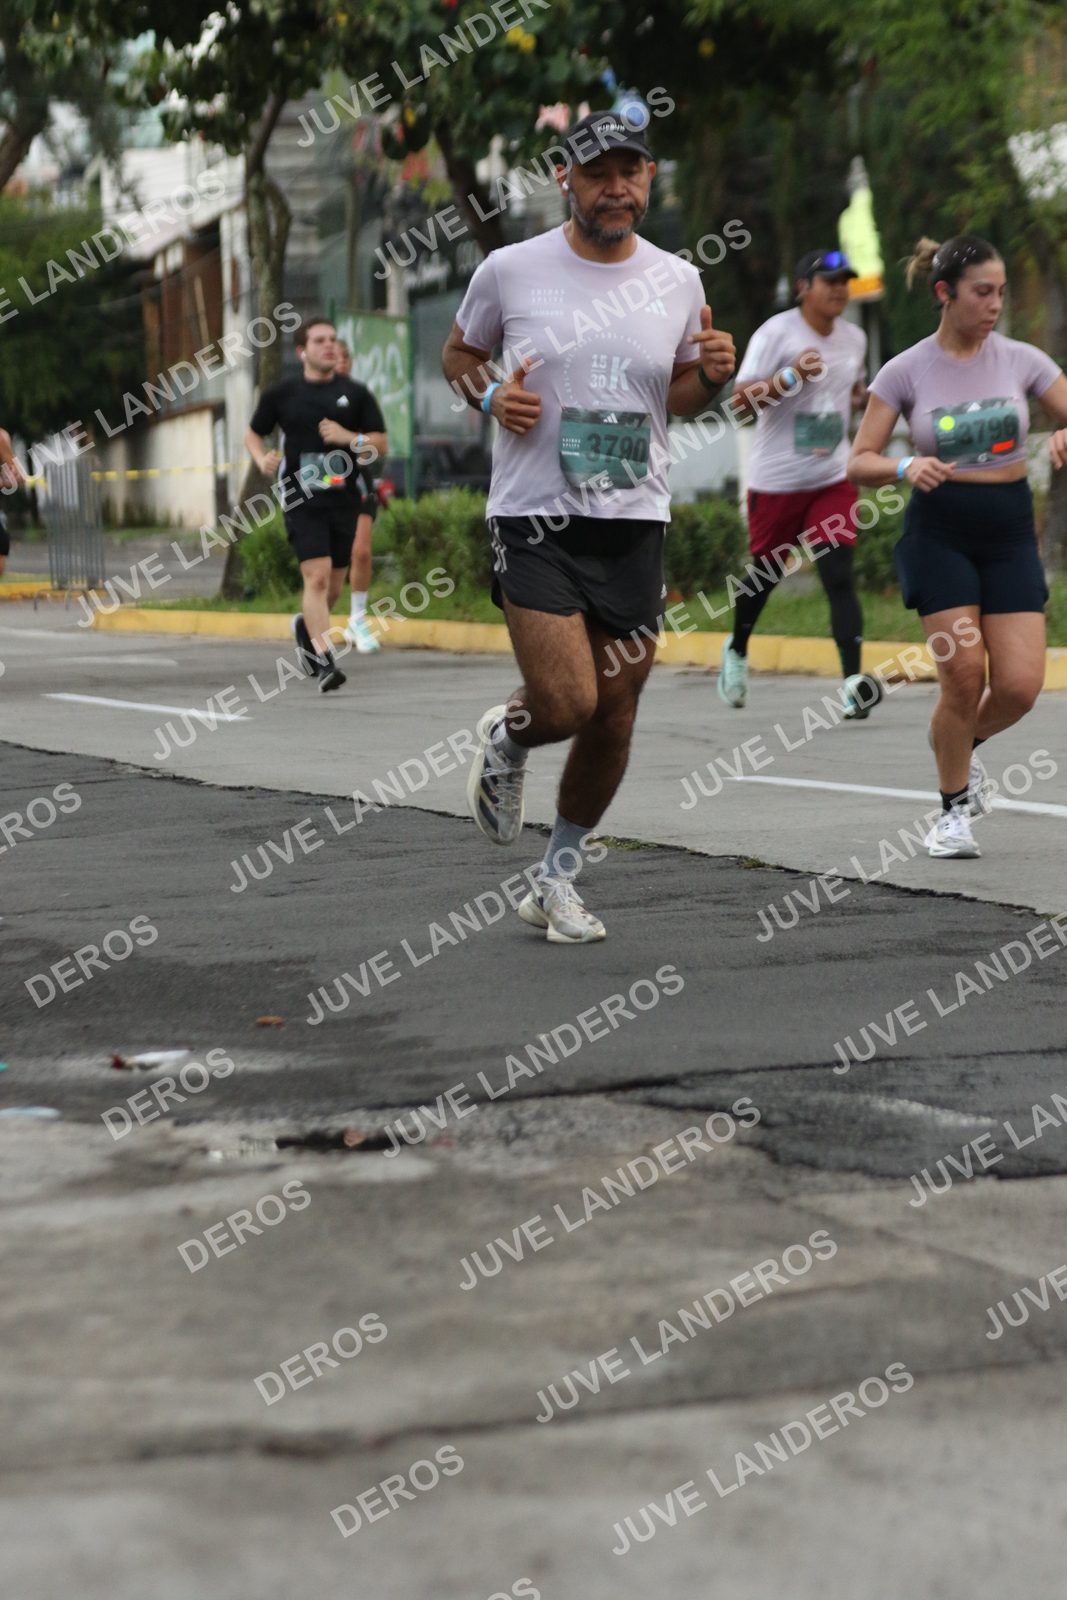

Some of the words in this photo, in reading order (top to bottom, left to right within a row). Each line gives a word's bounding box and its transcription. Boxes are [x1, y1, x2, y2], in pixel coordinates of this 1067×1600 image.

[591, 353, 608, 369] 15
[590, 373, 607, 389] 30
[609, 355, 633, 392] K
[587, 432, 648, 463] 3790
